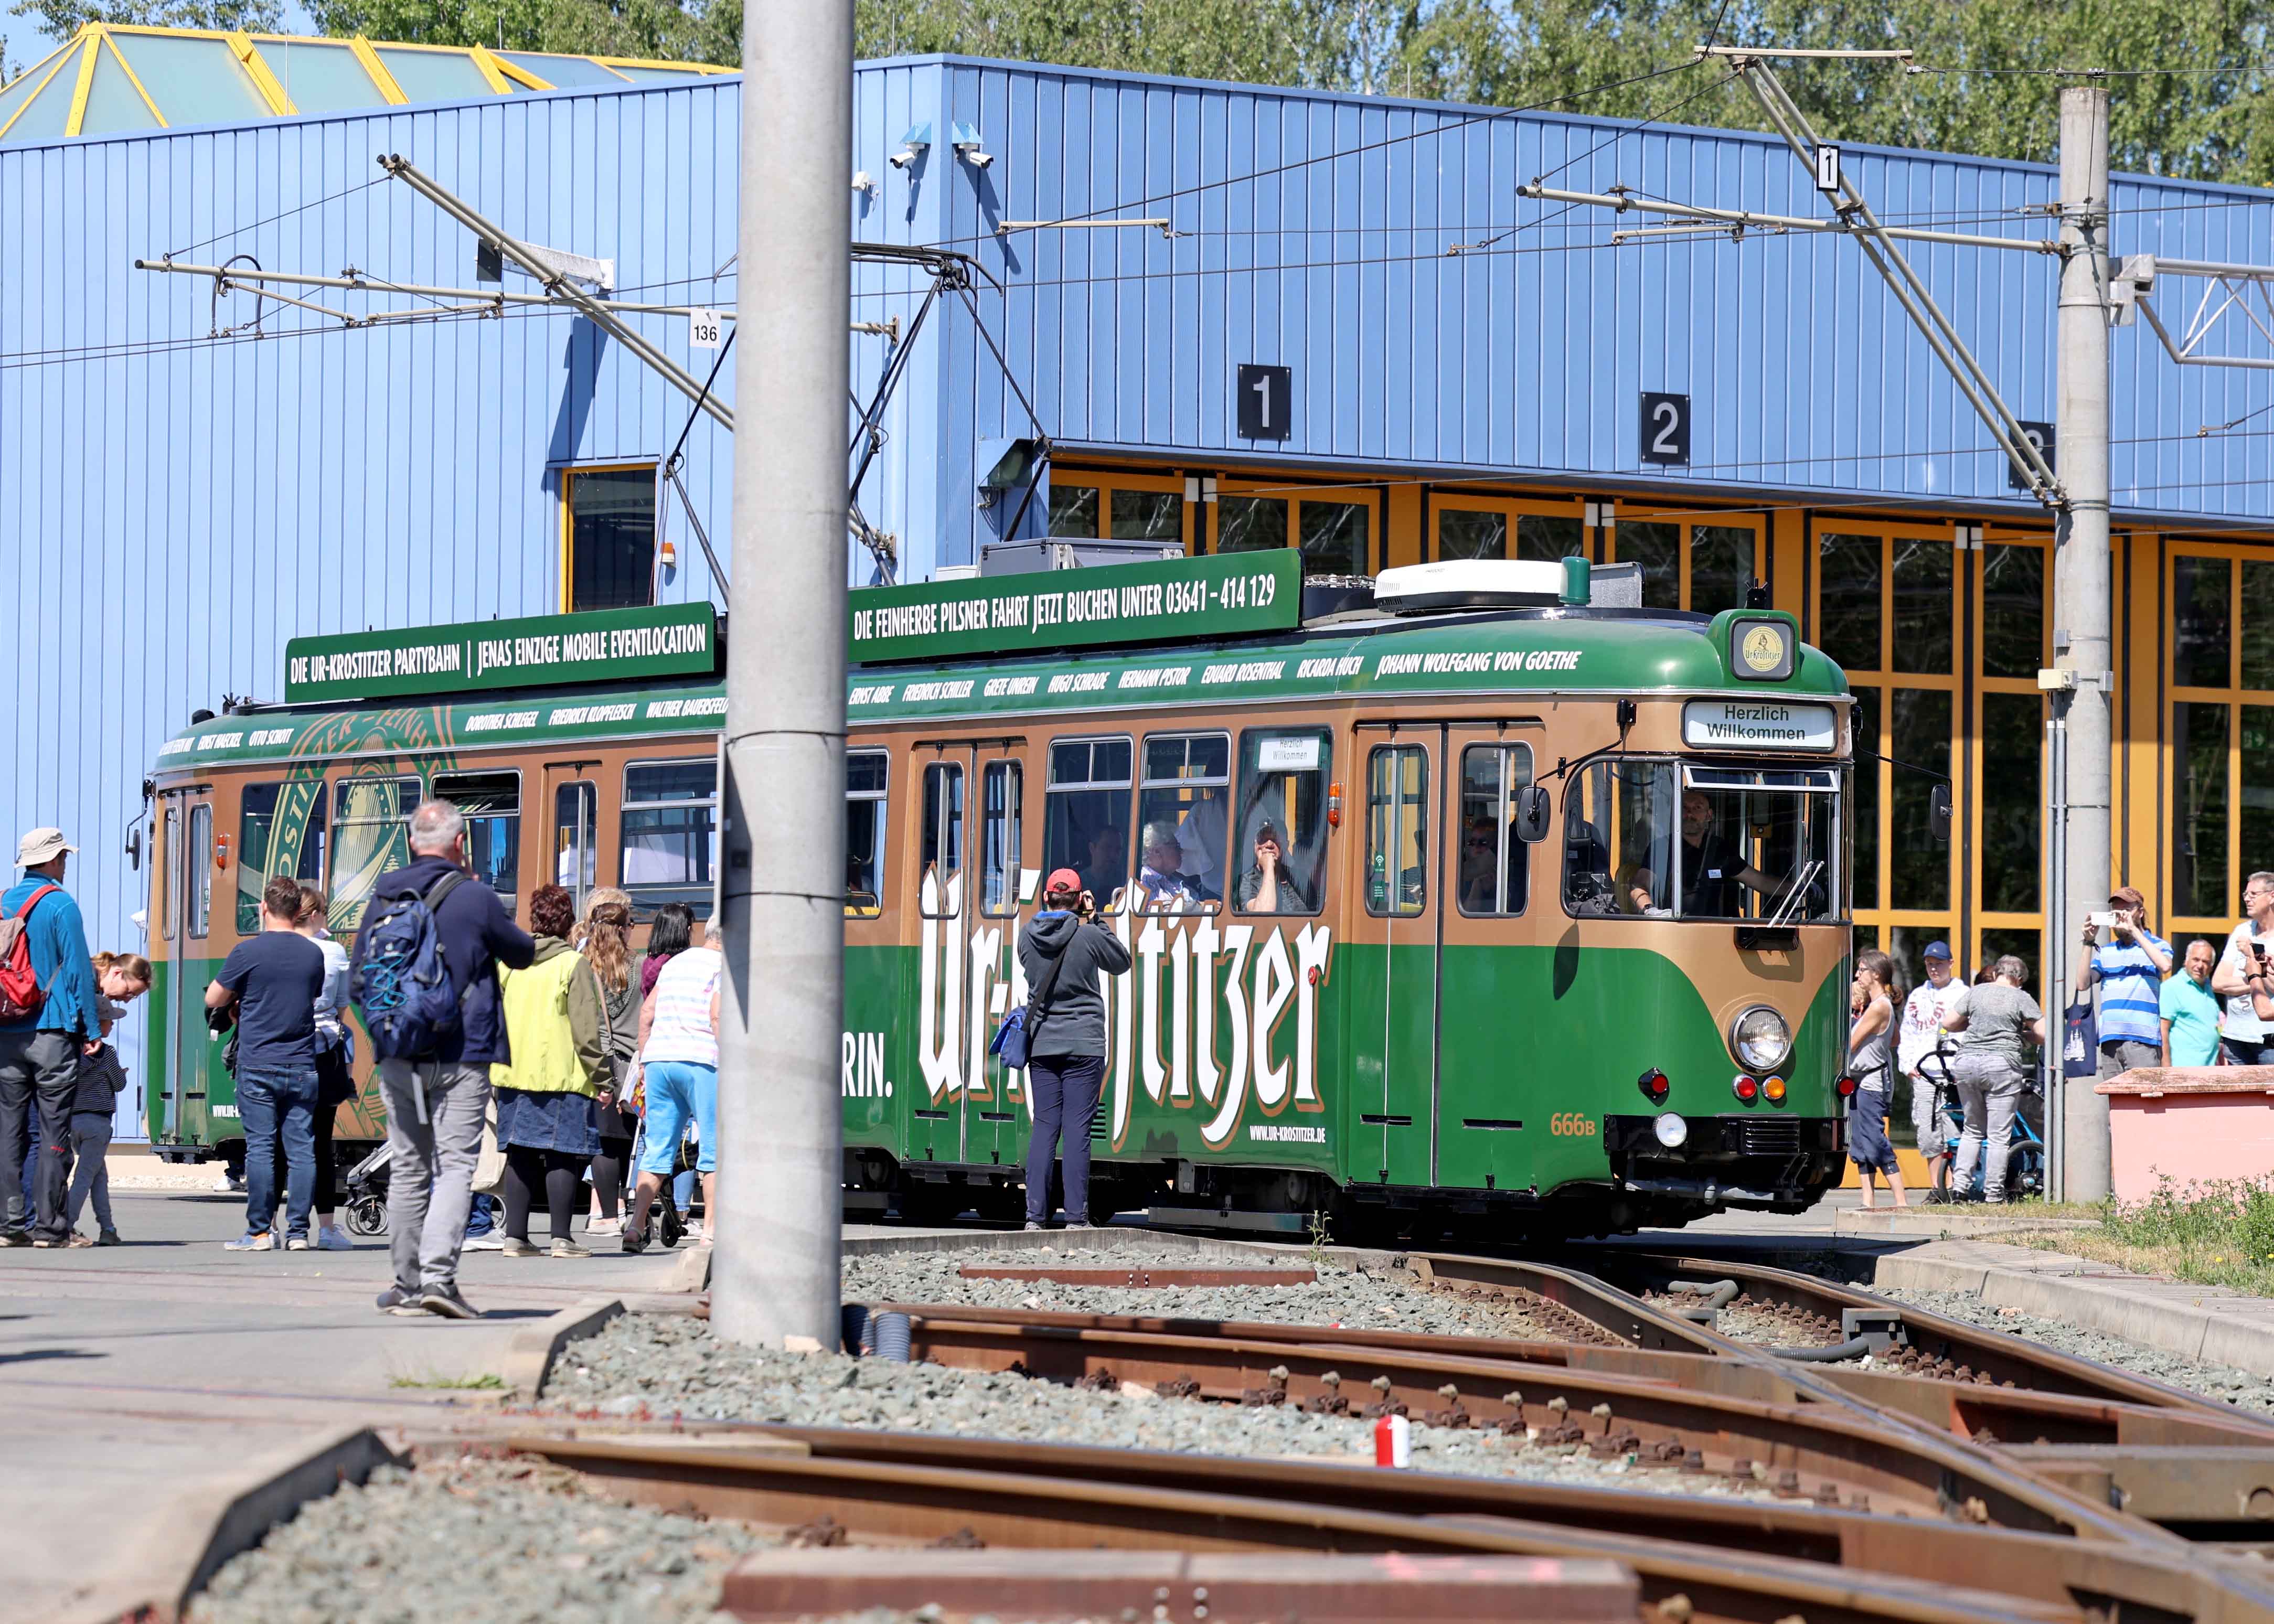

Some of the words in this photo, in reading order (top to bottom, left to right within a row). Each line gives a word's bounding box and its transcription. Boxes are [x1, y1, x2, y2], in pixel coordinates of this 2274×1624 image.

[1825, 155, 1831, 181] 1
[694, 325, 717, 341] 136
[1253, 375, 1271, 428] 1
[1652, 402, 1679, 454] 2
[854, 610, 872, 640] DIE
[876, 603, 937, 638] FEINHERBE
[940, 599, 988, 633] PILSNER
[991, 595, 1030, 628] FAHRT
[1031, 592, 1064, 634] JETZT
[1066, 587, 1117, 623] BUCHEN
[1121, 583, 1162, 618] UNTER
[1166, 579, 1207, 614] 03641
[1220, 576, 1246, 609] 414
[1250, 573, 1276, 607] 129
[291, 657, 308, 684] DIE
[311, 649, 391, 682] UR-KROSTITZER
[394, 643, 460, 675] PARTYBAHN
[477, 639, 511, 677] JENAS
[515, 635, 559, 666] EINZIGE
[562, 631, 607, 663] MOBILE
[611, 623, 706, 659] EVENTLOCATION
[1201, 664, 1239, 684] EDUARD
[1235, 660, 1286, 682] ROSENTHAL
[1297, 658, 1338, 678] RICARDA
[1336, 656, 1364, 676] HUCH
[1374, 654, 1423, 680] JOHANN
[1423, 652, 1493, 672] WOLFGANG
[1494, 651, 1526, 671] VON
[1525, 650, 1583, 670] GOETHE
[984, 678, 1010, 696] GRETE
[1007, 676, 1040, 695] UNREIN
[1048, 674, 1075, 693] HUGO
[1071, 672, 1111, 692] SCHRADE
[1118, 668, 1163, 689] HERMANN
[1159, 667, 1192, 686] PISTOR
[848, 687, 876, 704] ERNST
[871, 685, 895, 704] ABBE
[902, 682, 942, 702] FRIEDRICH
[939, 680, 975, 699] SCHILLER
[548, 707, 590, 725] FRIEDRICH
[586, 703, 637, 723] KLOPFLEISCH
[646, 700, 684, 718] WALTHER
[1725, 704, 1789, 721] Herzlich
[465, 713, 506, 732] DOROTHEA
[503, 710, 539, 729] SCHLEGEL
[1707, 723, 1806, 740] Willkommen
[249, 730, 270, 746] OTTO
[266, 728, 294, 745] SCHOTT
[1280, 738, 1303, 748] Herzlich
[1273, 751, 1307, 760] Willkommen
[1250, 1125, 1327, 1143] WWW.UR-KROSTITZER.DE
[1551, 1112, 1595, 1136] 666B
